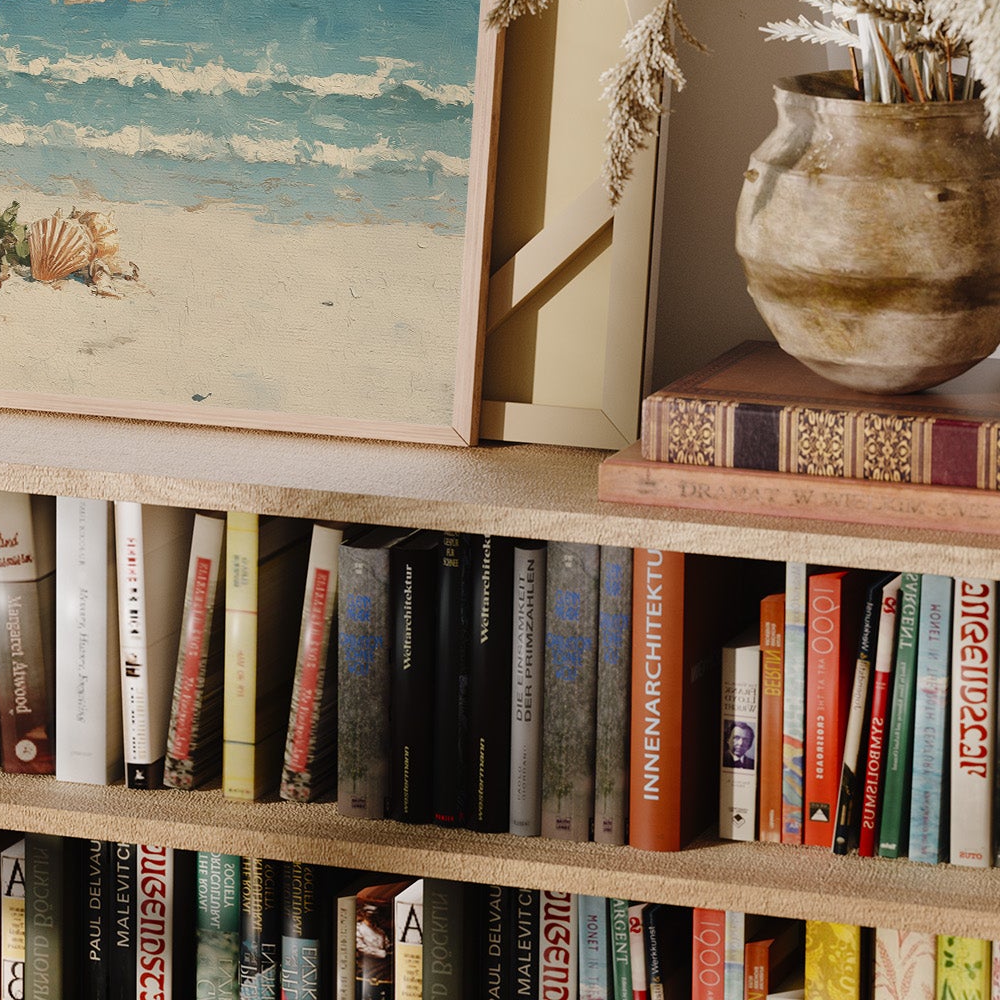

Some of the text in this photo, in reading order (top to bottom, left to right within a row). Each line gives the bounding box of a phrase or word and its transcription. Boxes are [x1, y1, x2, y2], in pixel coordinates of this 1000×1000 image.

[6, 594, 32, 714] Margaret Atwood
[403, 564, 413, 671] Weltarchitektur
[516, 573, 525, 722] DIE EINSAMKEIT
[524, 559, 535, 722] DER PRIMZAHLEN
[643, 550, 663, 800] INNENARCHITEKTU
[89, 840, 102, 961] PAUL DELVAU
[488, 885, 502, 956] DELVAU
[587, 914, 597, 952] MONET
[613, 899, 629, 965] ARGENT
[650, 926, 662, 973] Werkkunst
[699, 922, 721, 988] 1900
